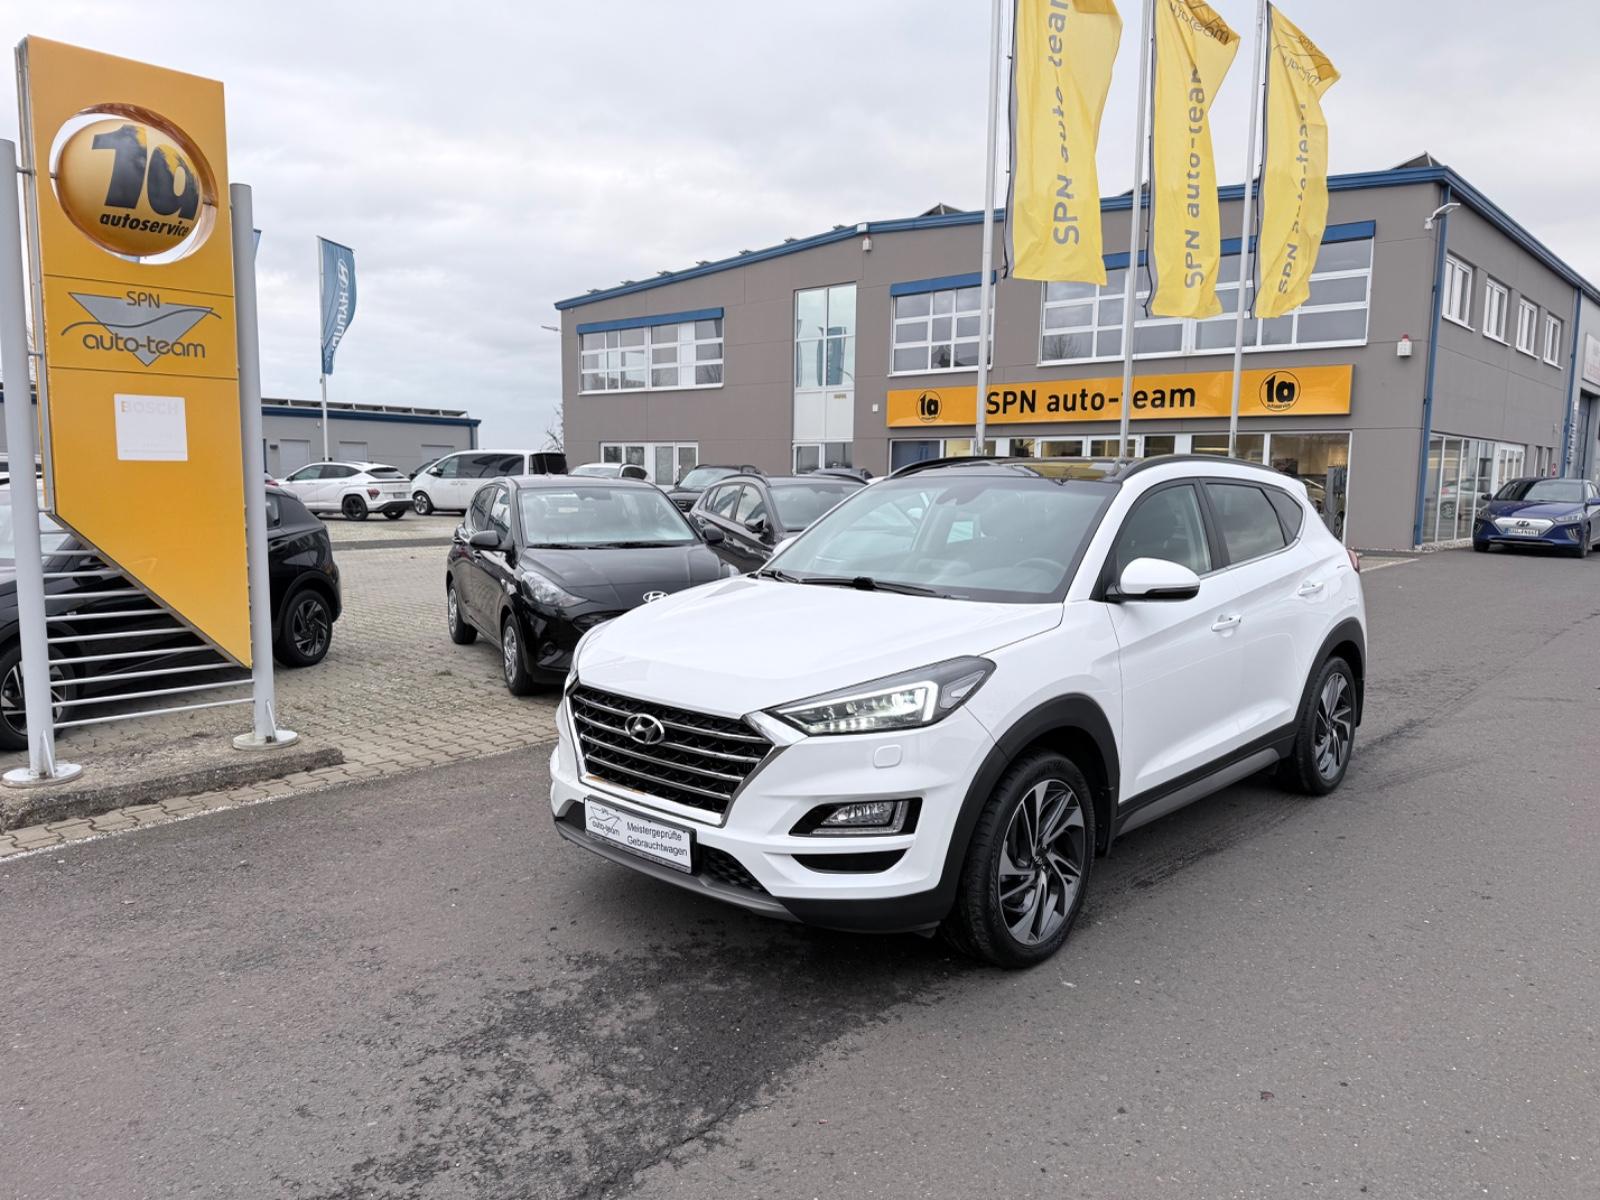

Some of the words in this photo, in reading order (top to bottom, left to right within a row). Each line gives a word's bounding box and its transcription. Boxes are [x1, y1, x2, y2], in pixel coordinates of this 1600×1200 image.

[91, 124, 199, 221] 1a
[1053, 174, 1080, 245] SPN
[100, 212, 190, 237] autoservice
[1184, 229, 1204, 289] SPN
[1278, 243, 1298, 294] SPN
[126, 290, 161, 309] SPN
[82, 332, 205, 359] auto-team
[986, 389, 1037, 415] SPN
[1046, 386, 1196, 412] auto-eam
[1265, 374, 1296, 403] 1a
[919, 393, 939, 416] 1a
[626, 821, 682, 841] Meistergeprüfte
[626, 835, 688, 857] Gebrauchtwagen
